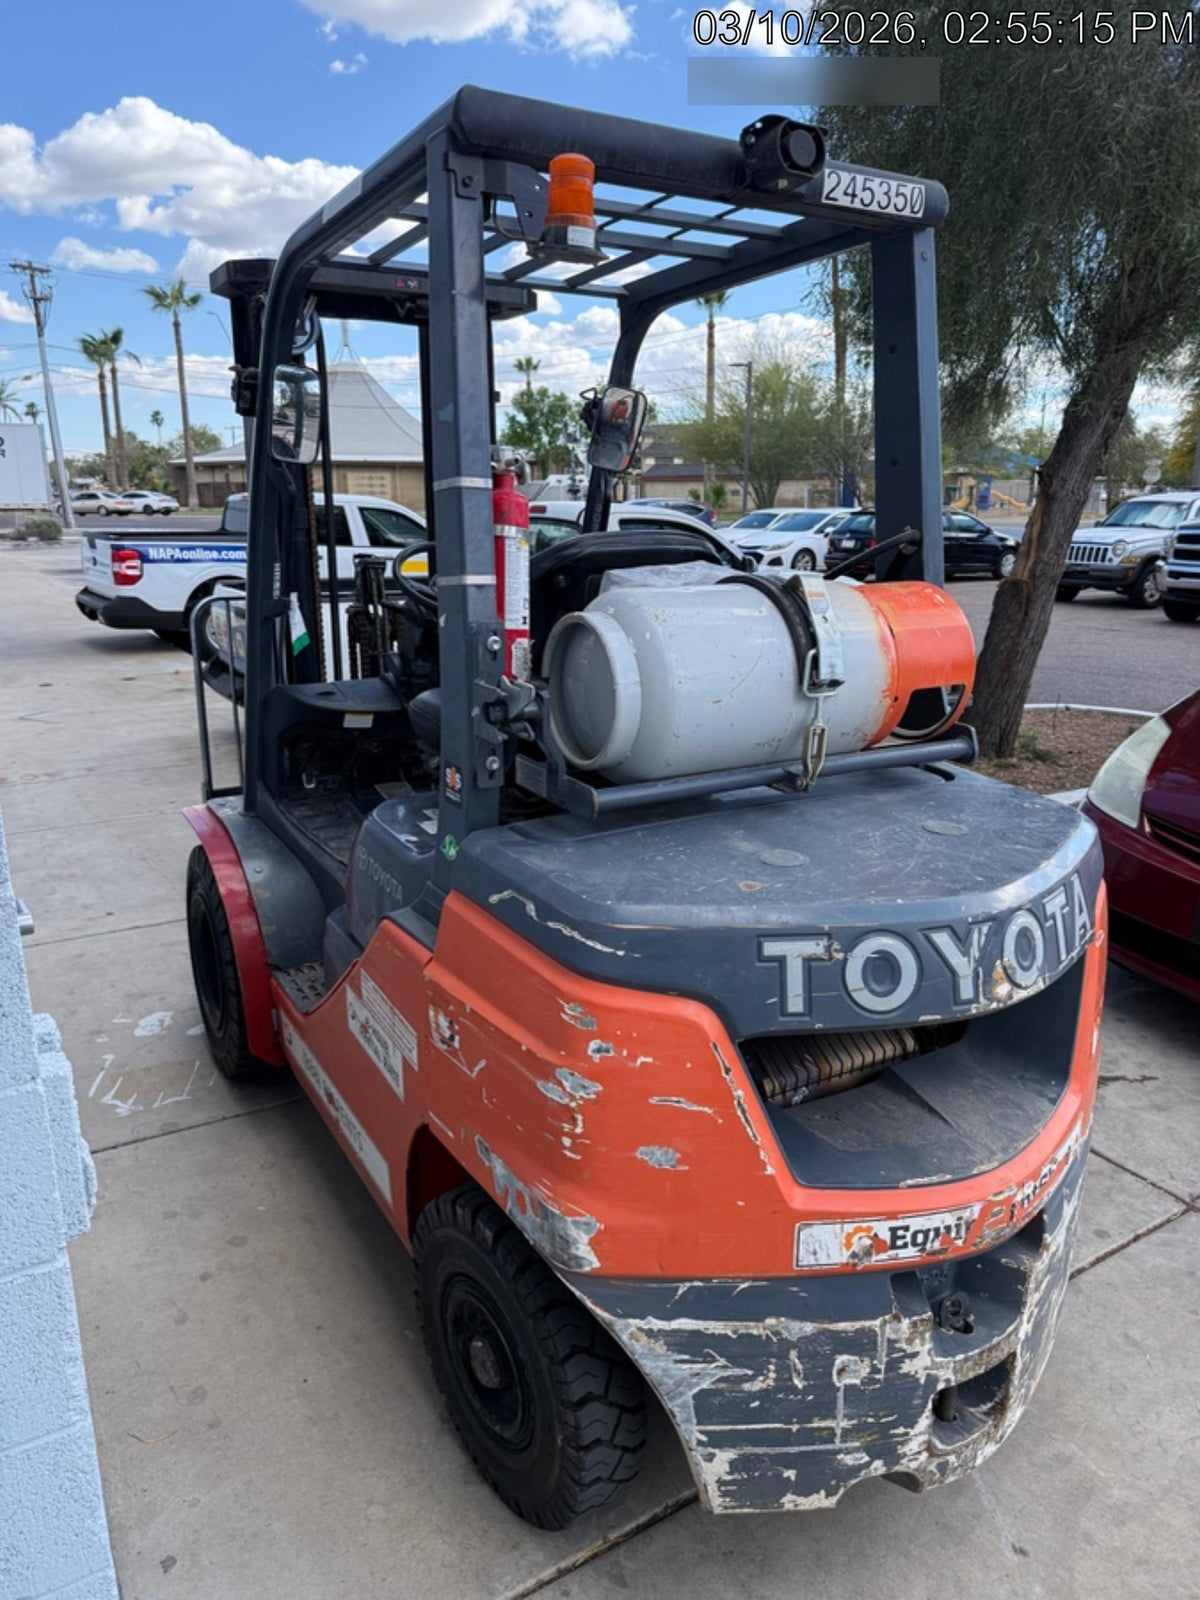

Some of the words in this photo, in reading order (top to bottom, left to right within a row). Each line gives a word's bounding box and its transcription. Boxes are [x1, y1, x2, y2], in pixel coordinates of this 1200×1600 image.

[824, 170, 924, 214] 245350
[148, 547, 247, 560] NAPAonline.com
[759, 872, 1093, 1015] TOYOTA
